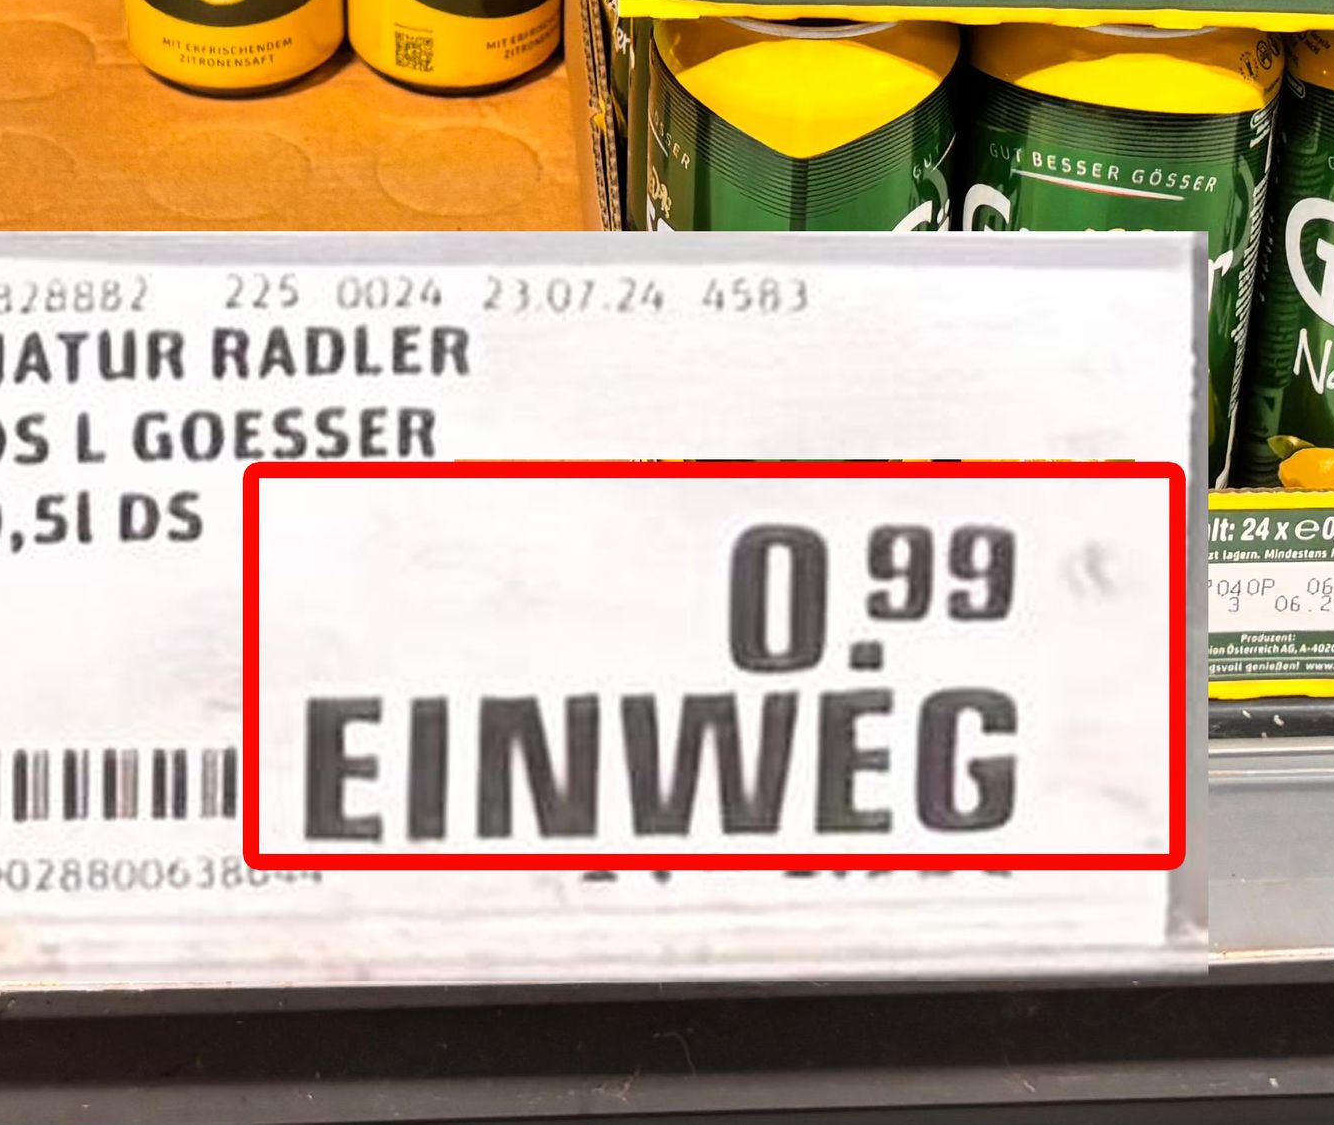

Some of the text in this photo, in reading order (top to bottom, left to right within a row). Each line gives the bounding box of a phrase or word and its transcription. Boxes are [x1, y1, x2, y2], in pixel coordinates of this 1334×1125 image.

[1032, 152, 1120, 181] BESSER
[1132, 168, 1217, 192] GÖSSER
[225, 273, 300, 308] 225
[337, 276, 443, 308] 0024
[483, 274, 664, 315] 23.07.24
[702, 278, 809, 315] 4583
[212, 325, 470, 379] RADLER
[76, 413, 106, 462] L
[132, 406, 436, 461] GOESSER
[118, 491, 203, 543] DS
[1241, 517, 1270, 541] 24
[1275, 520, 1288, 540] x
[1223, 550, 1260, 560] lagern.
[1265, 549, 1326, 560] Mindestens
[728, 522, 1017, 674] 0.99
[1241, 634, 1296, 643] Produzent:
[302, 687, 1019, 841] EINWEG
